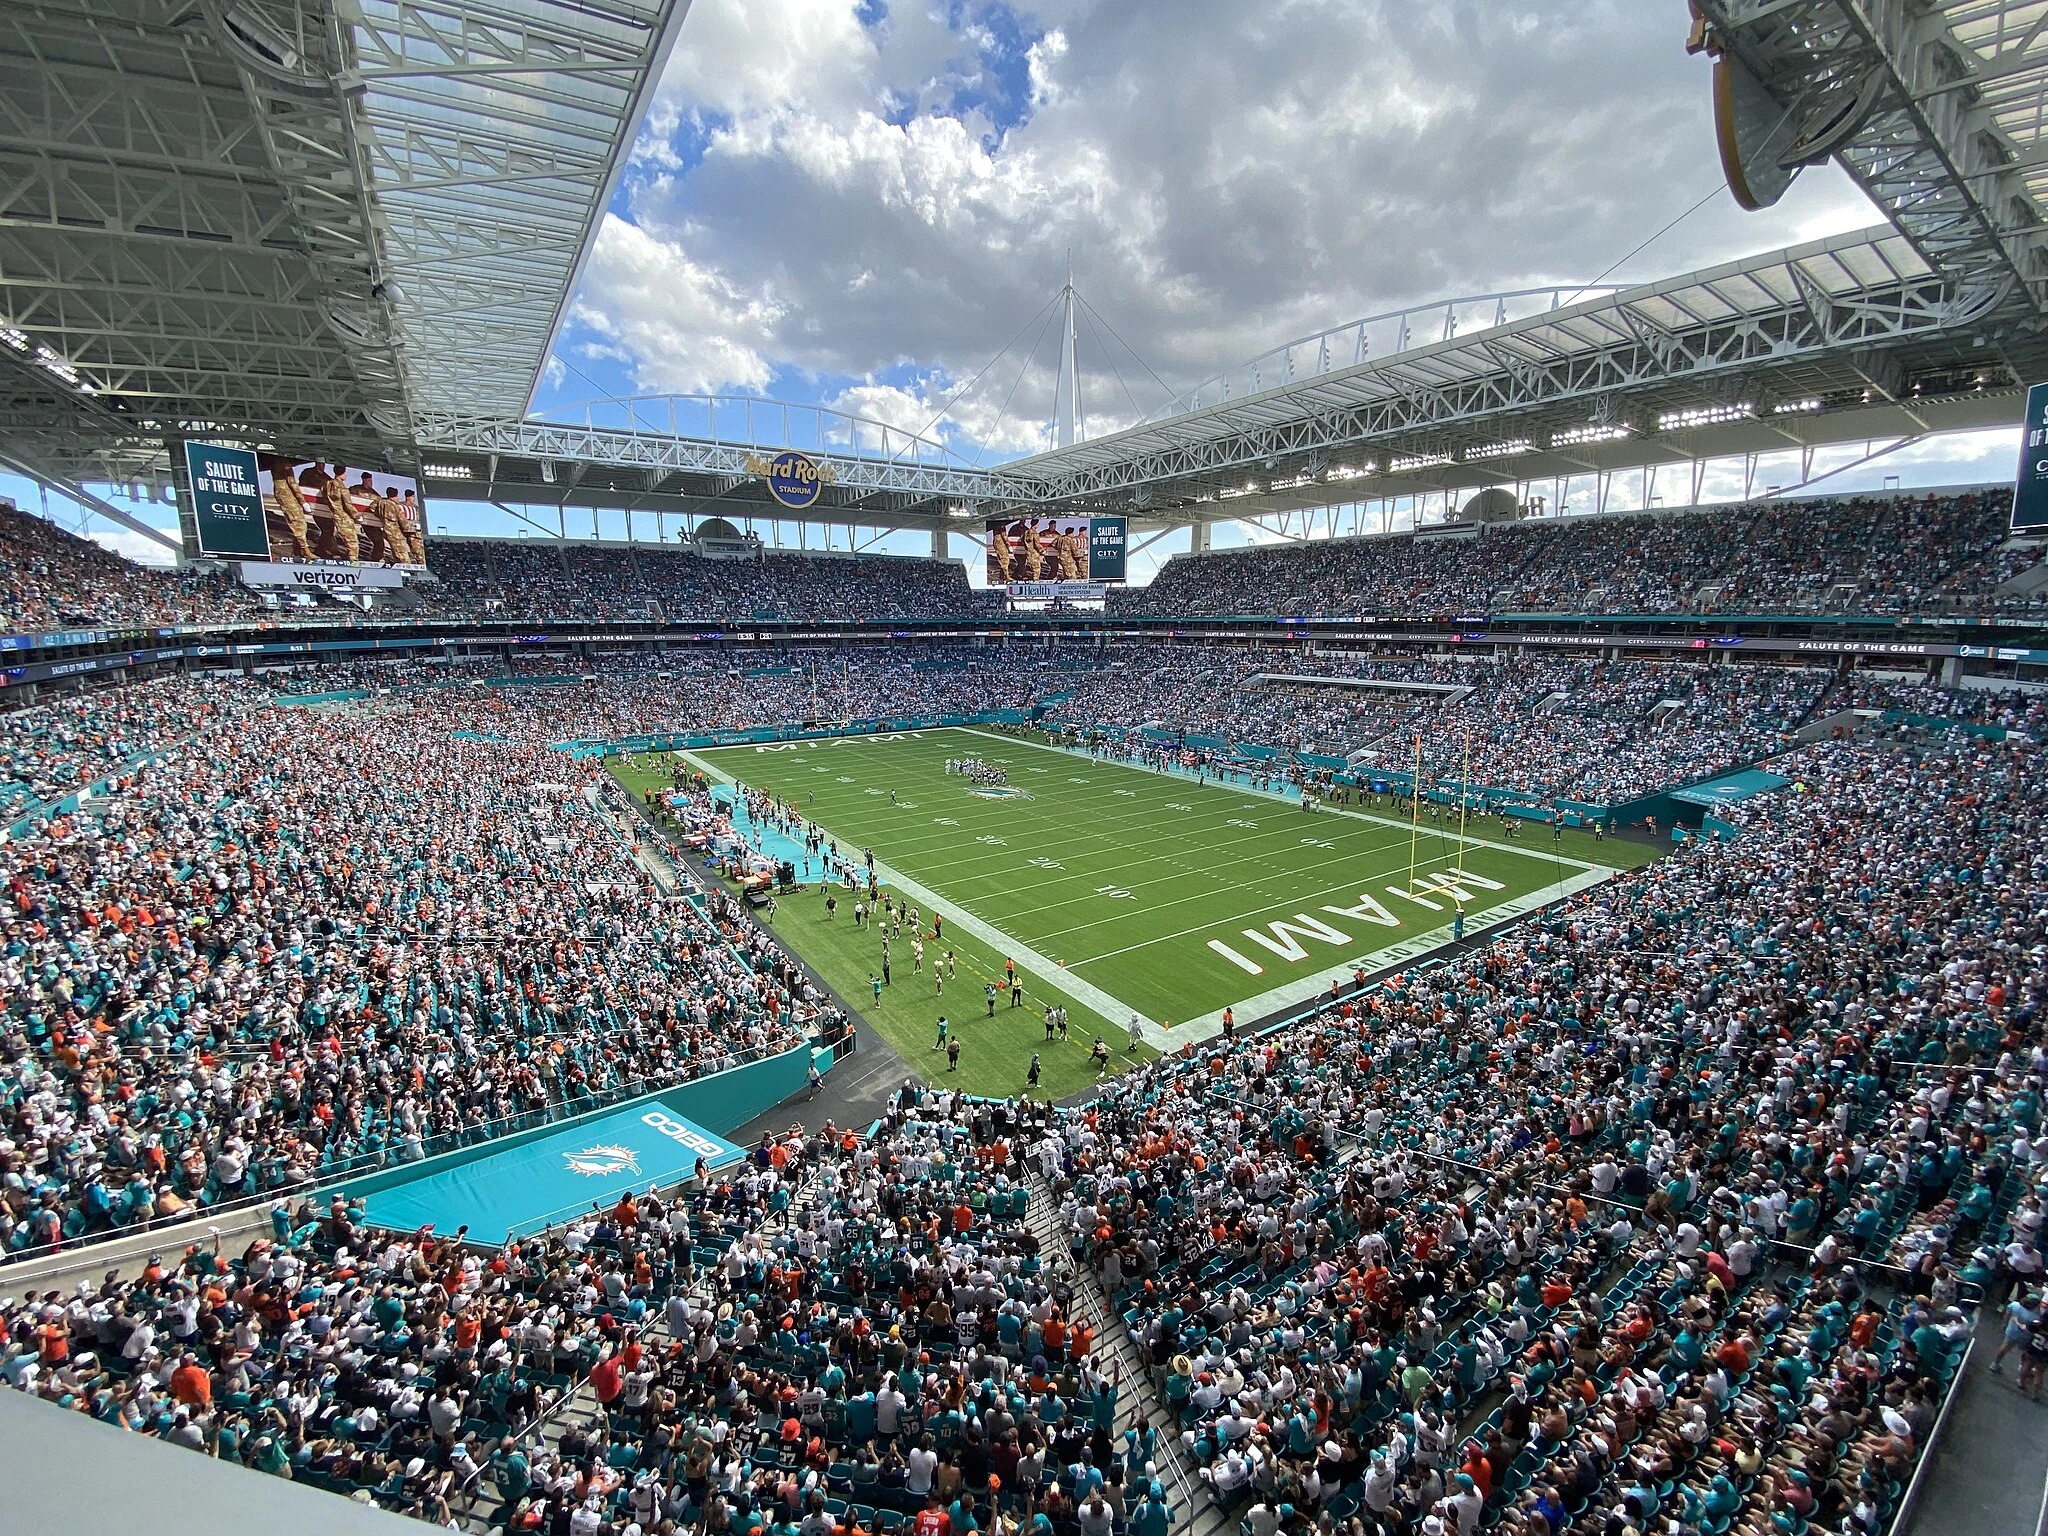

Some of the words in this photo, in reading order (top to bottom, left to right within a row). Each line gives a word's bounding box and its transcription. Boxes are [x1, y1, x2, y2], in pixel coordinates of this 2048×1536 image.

[2029, 429, 2043, 448] OF
[204, 460, 245, 481] SALUTE
[745, 453, 793, 478] Hard
[795, 459, 839, 487] Rock
[197, 477, 210, 492] OF
[211, 479, 230, 494] THE
[230, 481, 257, 497] GAME
[778, 485, 812, 495] STADIUM
[211, 503, 249, 515] CITY
[1097, 526, 1119, 537] SALUTE
[1092, 537, 1099, 546] OF
[1099, 537, 1109, 545] THE
[1109, 536, 1124, 545] GAME
[293, 569, 356, 585] verizon
[1997, 619, 2016, 627] 1972
[1798, 642, 1839, 650] SALUTE
[1890, 644, 1925, 653] GAME
[51, 666, 69, 675] SALUTE
[69, 664, 76, 672] OF
[76, 662, 85, 671] THE
[85, 660, 97, 670] GAME
[720, 736, 750, 744] Dolphins
[755, 732, 924, 753] MIAMI
[1026, 856, 1060, 870] 20
[1093, 884, 1131, 898] 10
[1206, 867, 1506, 977] MIAMI
[1386, 947, 1413, 962] OF
[1346, 957, 1384, 973] US
[640, 1112, 725, 1158] GEICO
[981, 1155, 987, 1163] 9
[1197, 1197, 1208, 1207] 24
[846, 1228, 858, 1239] 25
[1125, 1255, 1137, 1266] 24
[1184, 1247, 1198, 1263] 32
[654, 1267, 664, 1278] 13
[575, 1294, 587, 1304] 24
[959, 1323, 974, 1337] 95
[672, 1376, 685, 1387] 13
[940, 1428, 952, 1438] 10
[735, 1441, 753, 1456] 24
[779, 1452, 796, 1467] 27
[492, 1467, 509, 1485] 13
